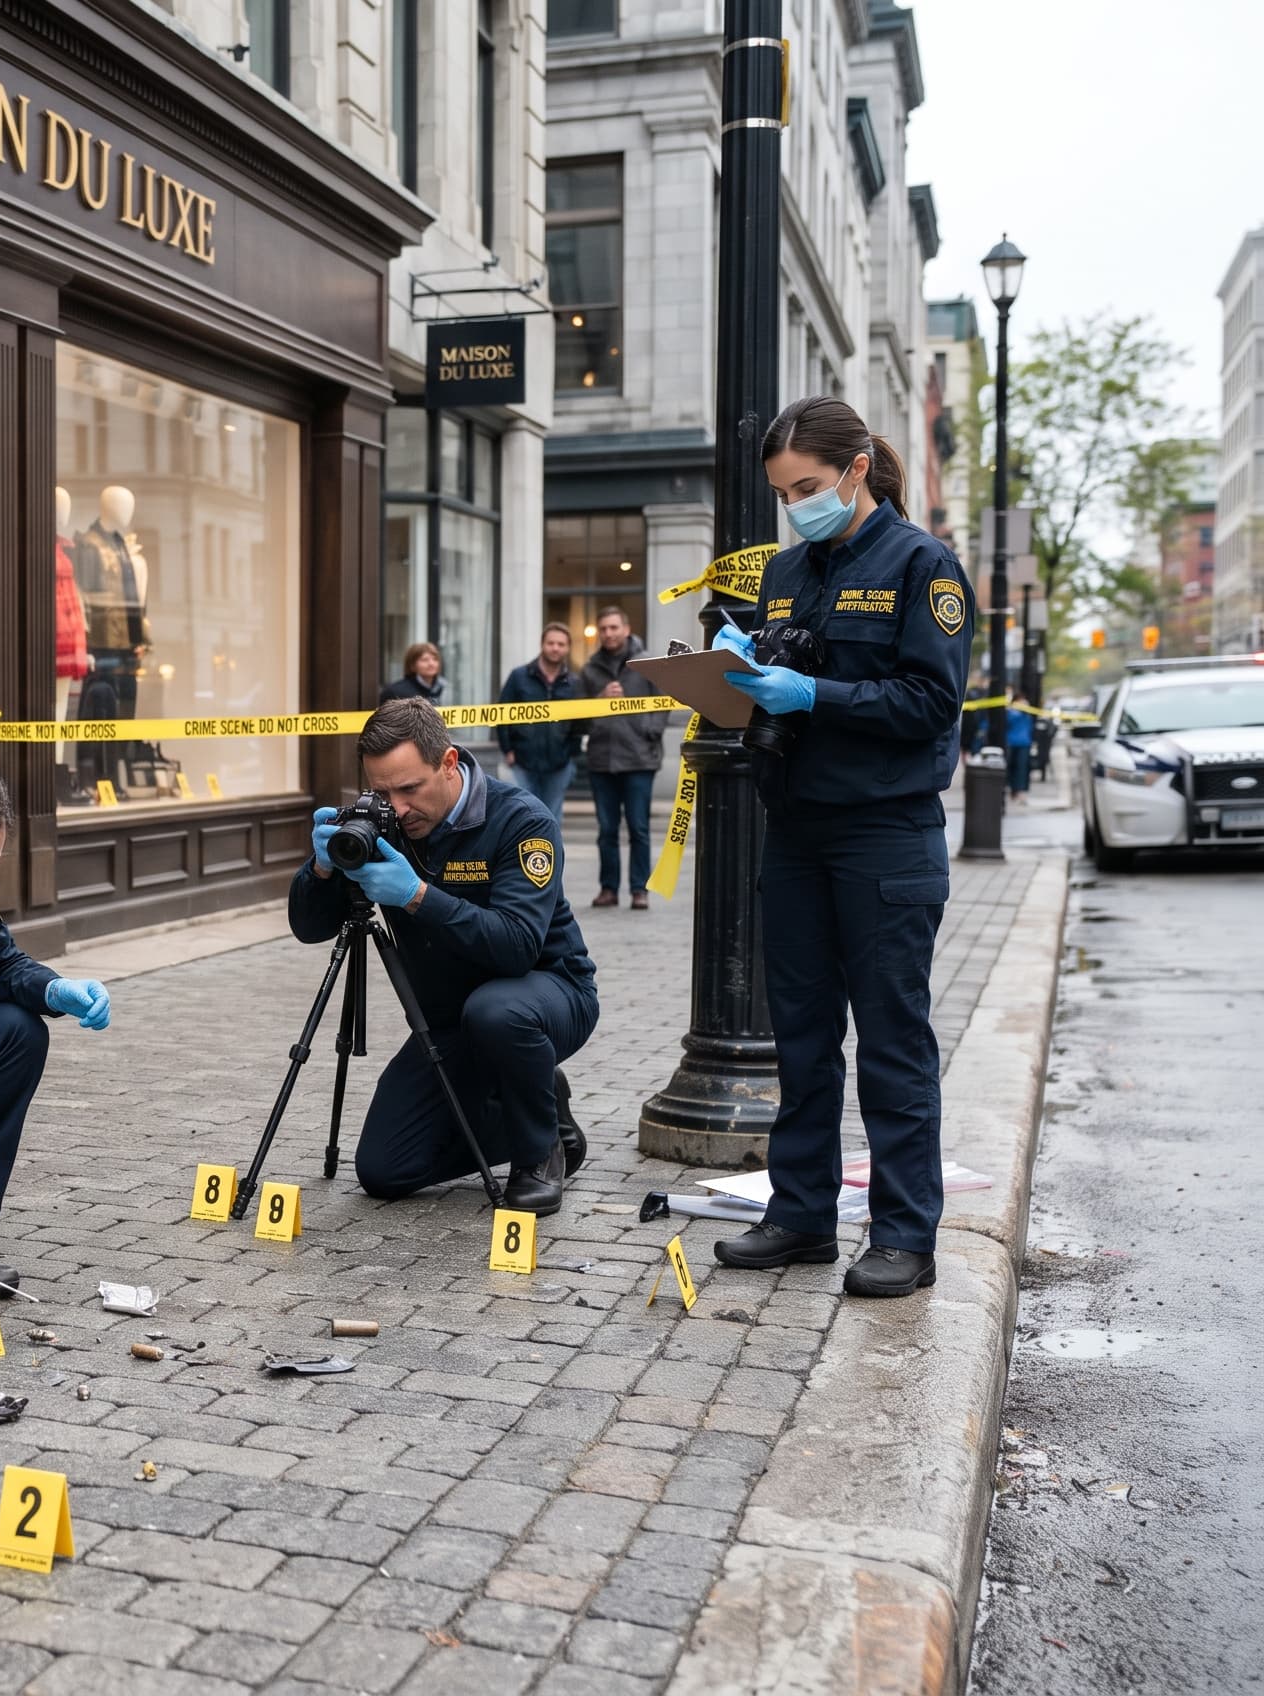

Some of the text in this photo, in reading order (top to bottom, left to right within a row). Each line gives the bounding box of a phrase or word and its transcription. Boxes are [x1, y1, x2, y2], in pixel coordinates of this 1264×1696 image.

[42, 108, 112, 210] DU
[120, 151, 217, 266] LUXE
[440, 345, 511, 364] MAISON
[439, 362, 515, 381] DU LUXE
[461, 708, 477, 724] DO
[480, 706, 505, 723] NOT
[508, 703, 551, 722] CROSS
[609, 698, 647, 712] CRIME
[60, 723, 81, 739] NOT
[83, 722, 117, 739] CROSS
[184, 716, 339, 736] CRIME SCENE DO NOT CROSS
[204, 1174, 221, 1204] 8
[504, 1221, 521, 1254] 8
[14, 1485, 42, 1539] 2
